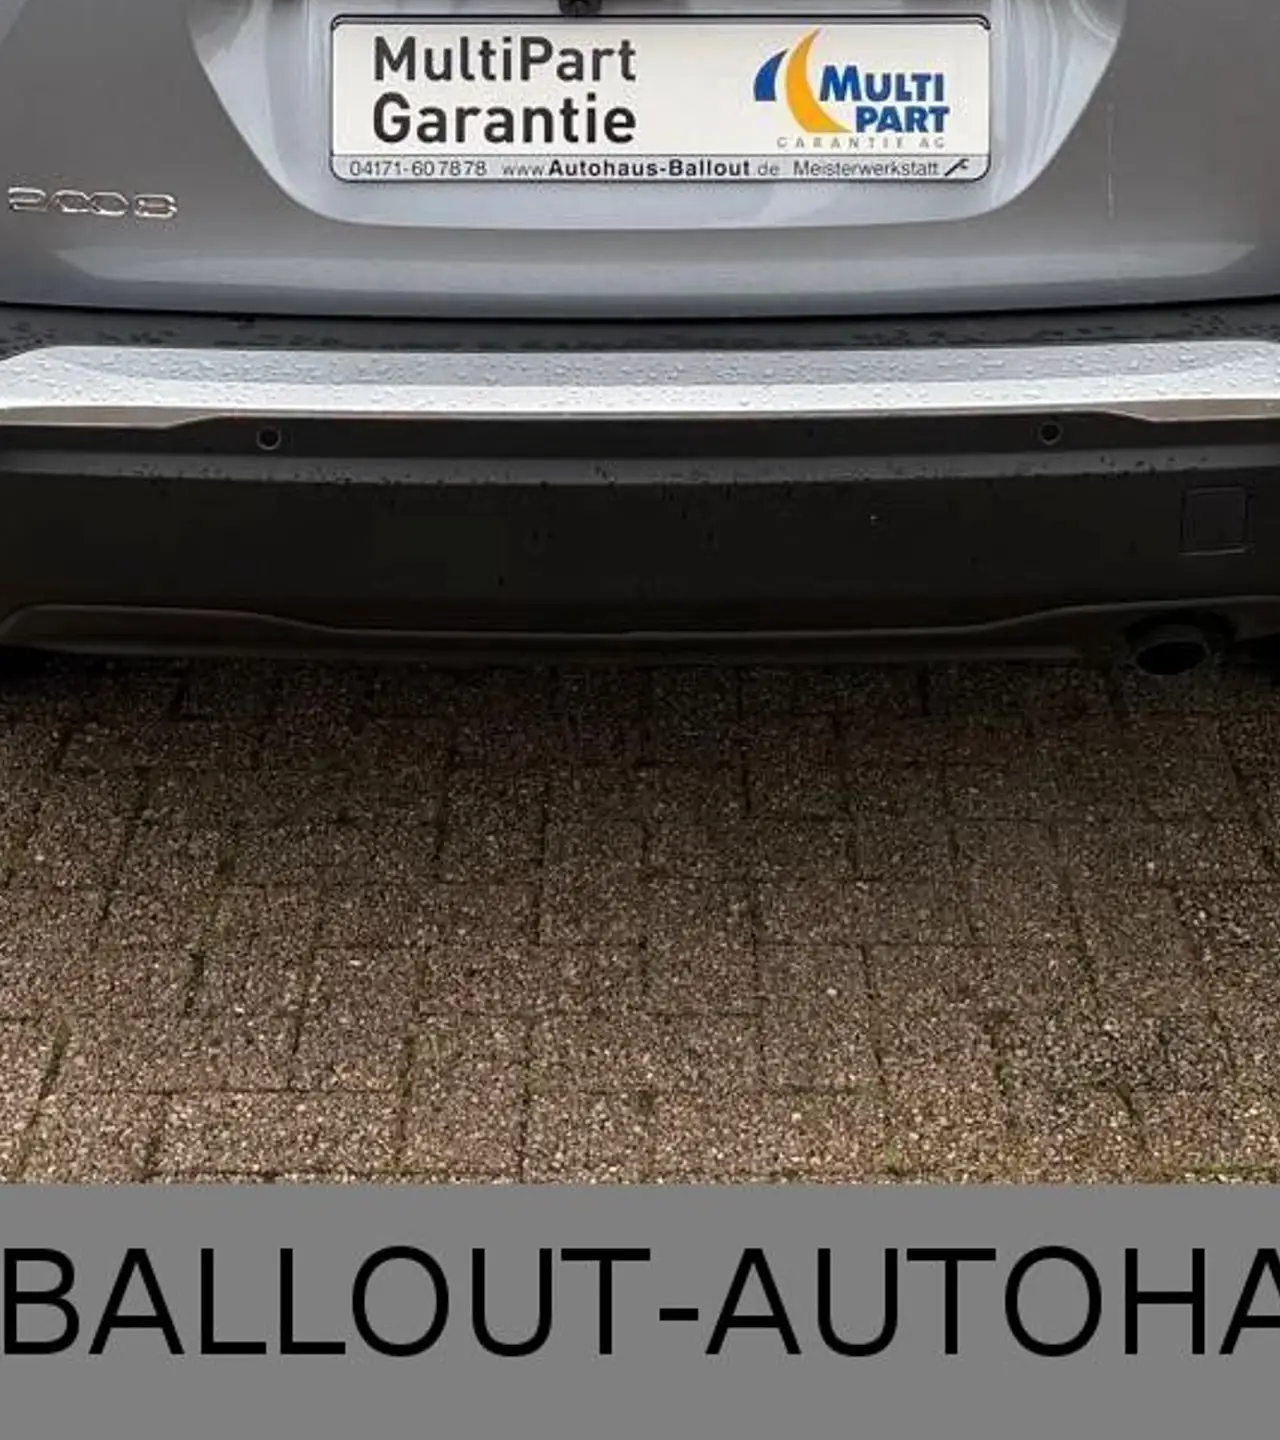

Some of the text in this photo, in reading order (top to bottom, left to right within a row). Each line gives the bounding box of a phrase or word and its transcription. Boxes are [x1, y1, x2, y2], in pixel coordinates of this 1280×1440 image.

[374, 35, 636, 82] MultiPart
[819, 64, 945, 102] MULTI
[373, 91, 637, 144] Garantie
[855, 106, 950, 134] PART
[792, 159, 939, 177] Meisterwerkstatt
[7, 186, 179, 219] 2008
